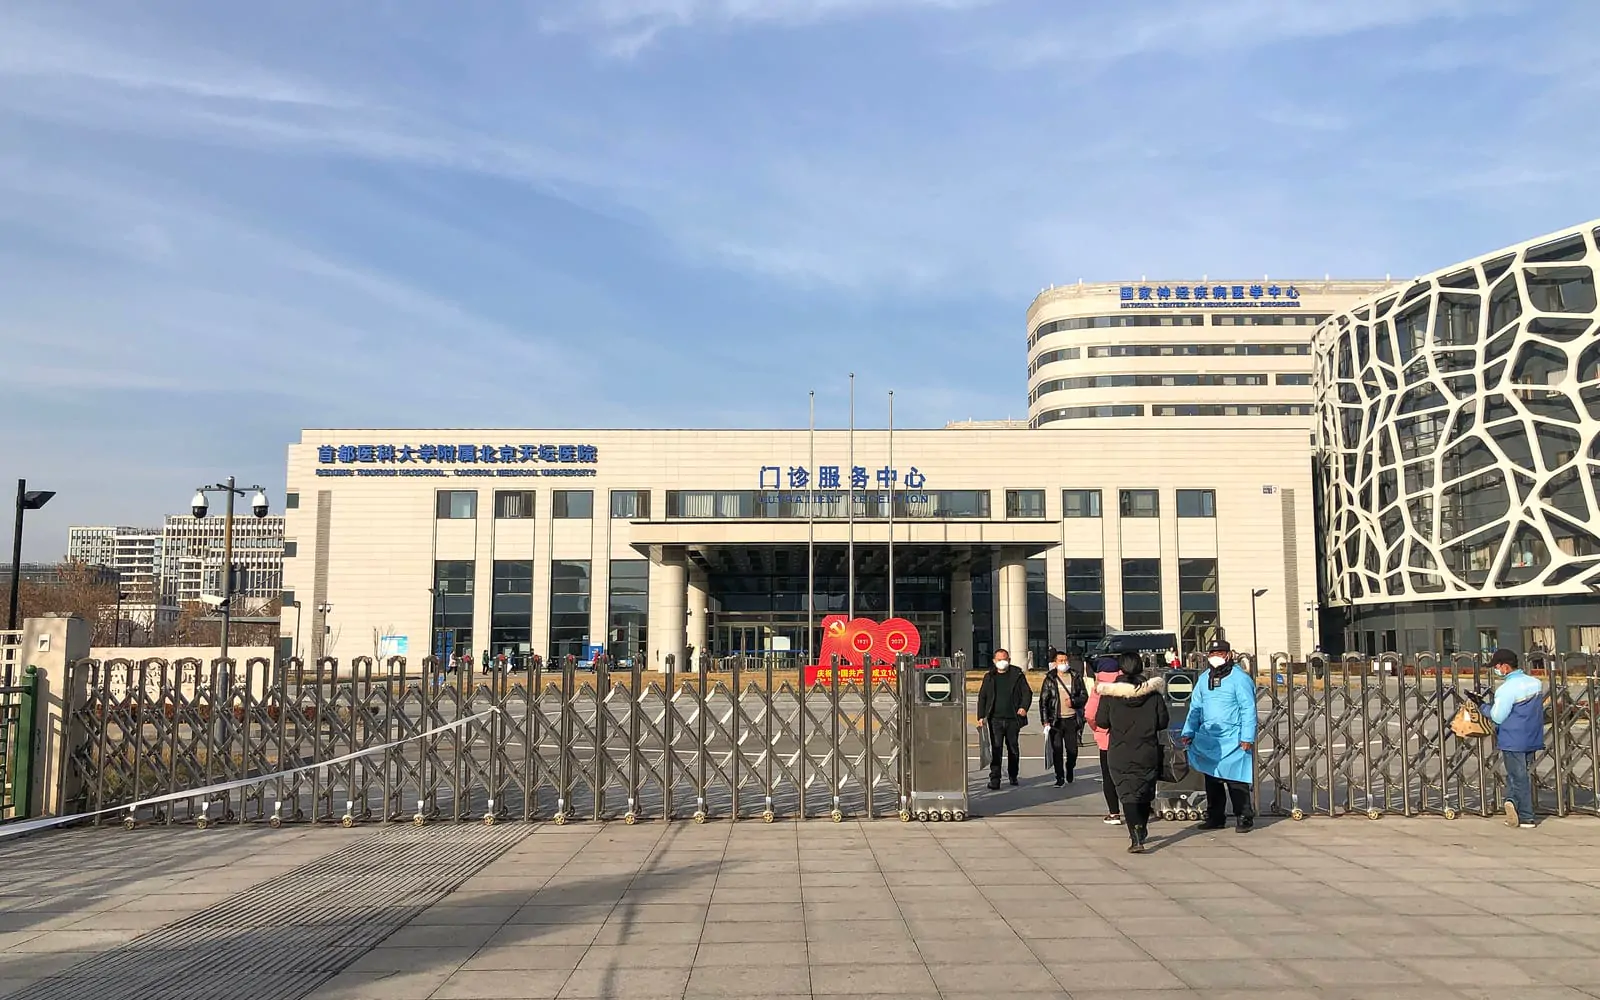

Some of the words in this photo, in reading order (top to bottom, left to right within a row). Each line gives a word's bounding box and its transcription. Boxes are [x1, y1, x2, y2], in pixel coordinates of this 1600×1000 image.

[1120, 286, 1300, 300] 国家神经疾病医学中心
[317, 444, 598, 464] 首都医科大学附属北京天坛医院
[759, 465, 926, 489] 门诊服务中心
